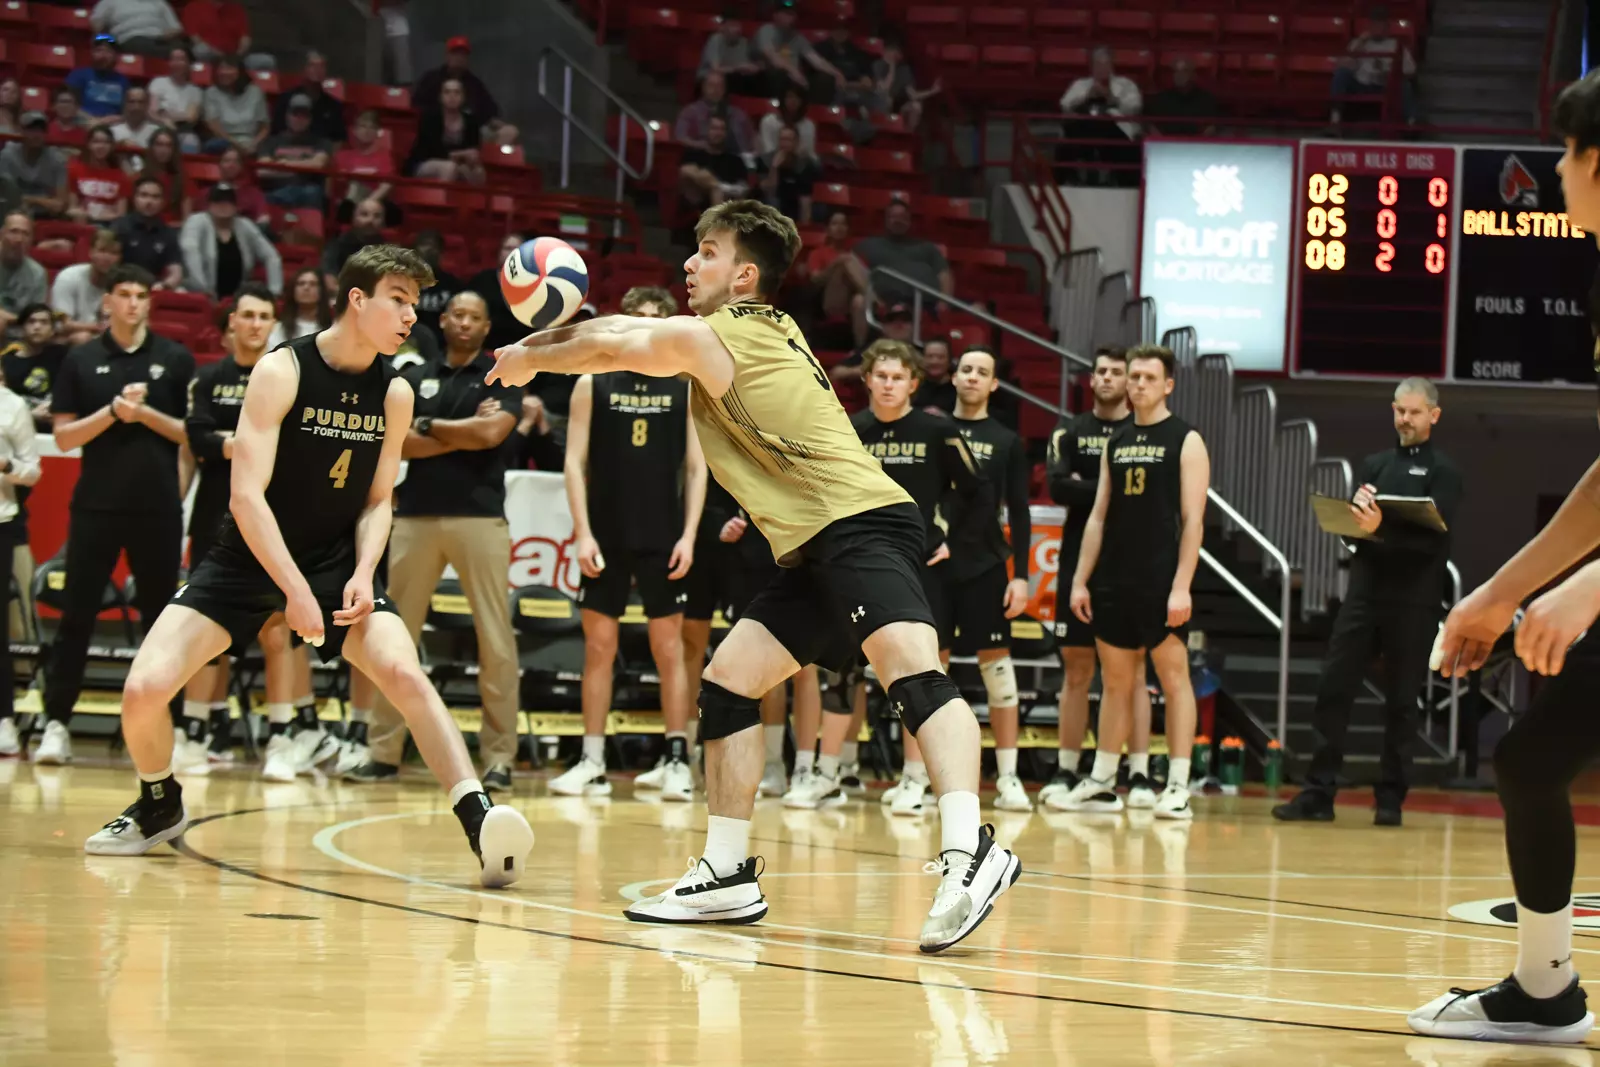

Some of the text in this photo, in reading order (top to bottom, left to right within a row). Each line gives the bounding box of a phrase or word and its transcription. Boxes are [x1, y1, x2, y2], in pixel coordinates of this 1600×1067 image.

[1326, 152, 1436, 170] PLYR KILLS DIGS
[1308, 173, 1448, 207] 02 0 0
[1307, 206, 1447, 239] 05 0 1
[1463, 209, 1515, 236] BALL
[1154, 218, 1279, 259] Ruoff
[1305, 239, 1446, 274] 08 2 0
[1153, 260, 1274, 284] MORTGAGE
[1475, 296, 1585, 316] FOULS T.O.L.
[1472, 361, 1523, 379] SCORE
[212, 384, 247, 398] PUR
[609, 393, 672, 407] PURDUE
[313, 426, 376, 442] FORT WAYNE
[631, 418, 648, 447] 8
[863, 442, 927, 457] URDUE
[1113, 445, 1166, 458] PURDUE
[328, 448, 353, 489] 4
[1124, 466, 1146, 495] 13
